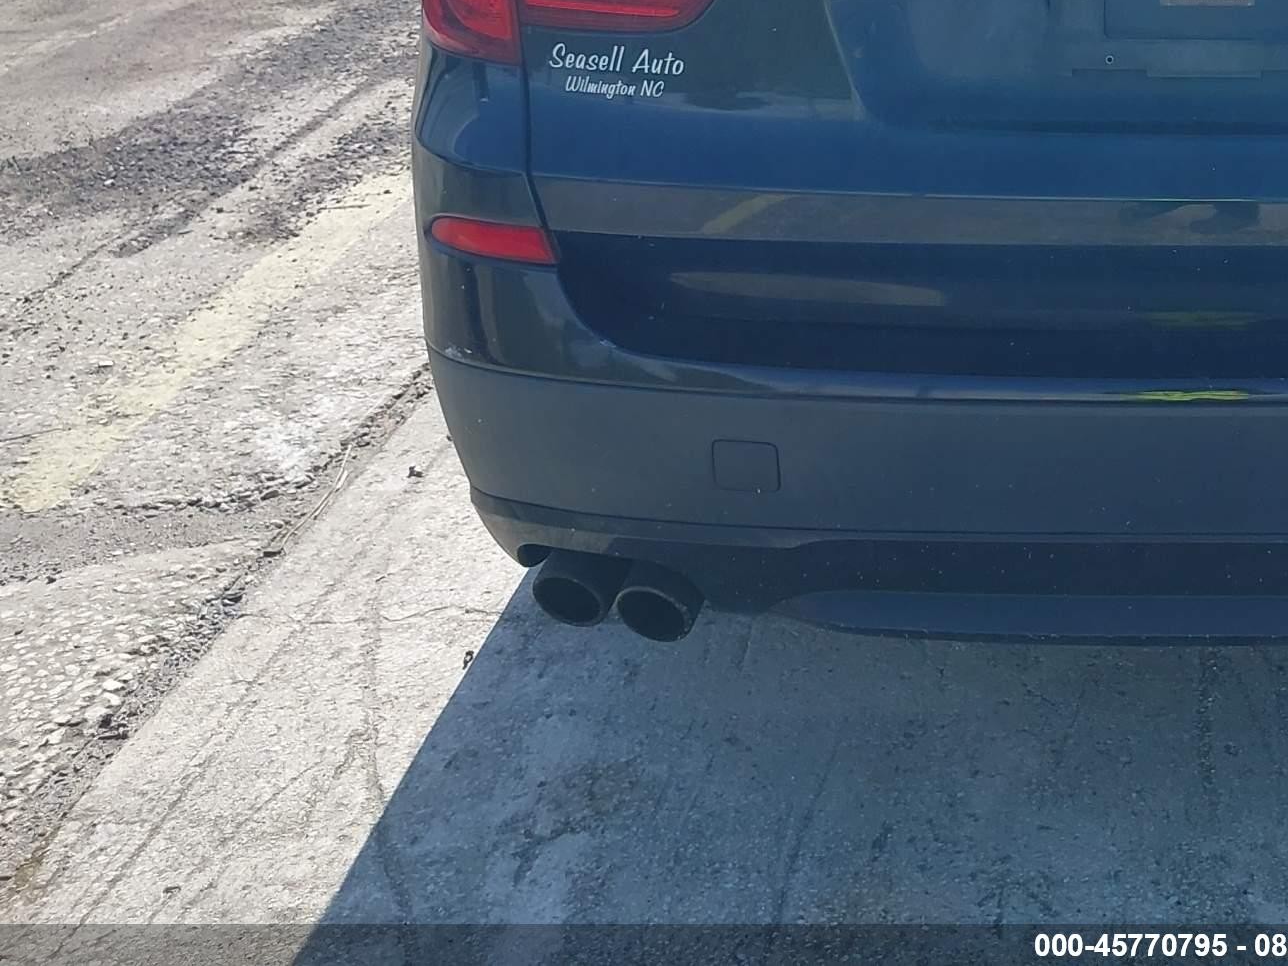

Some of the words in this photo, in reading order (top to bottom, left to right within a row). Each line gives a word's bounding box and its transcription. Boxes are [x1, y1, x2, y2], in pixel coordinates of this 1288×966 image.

[549, 43, 624, 72] Seasell
[632, 49, 684, 75] Auto
[565, 76, 636, 99] Wilmington
[640, 80, 665, 98] NC
